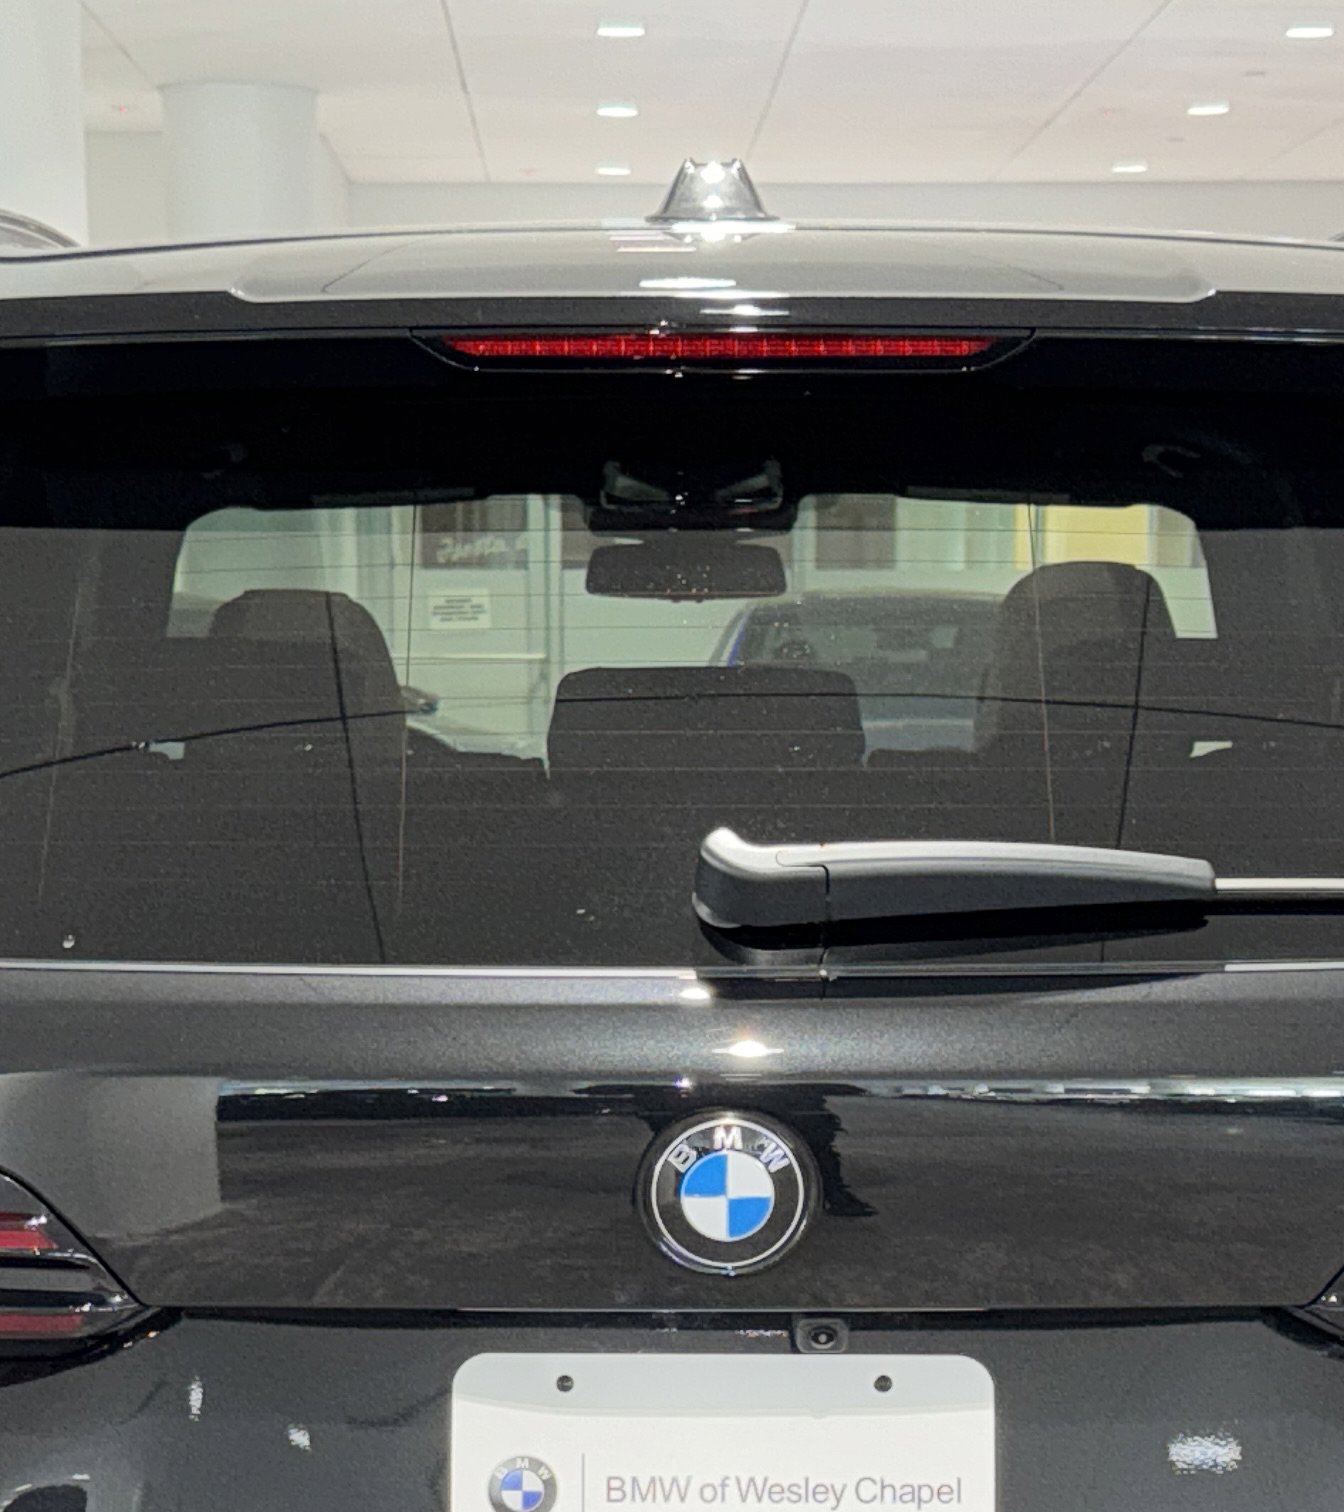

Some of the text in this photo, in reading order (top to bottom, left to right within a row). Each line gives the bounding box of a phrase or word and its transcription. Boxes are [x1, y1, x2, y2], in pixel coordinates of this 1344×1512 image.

[667, 1124, 791, 1174] BMW
[494, 1456, 553, 1481] BMW
[604, 1475, 963, 1511] BMW of Wesley Chapel
